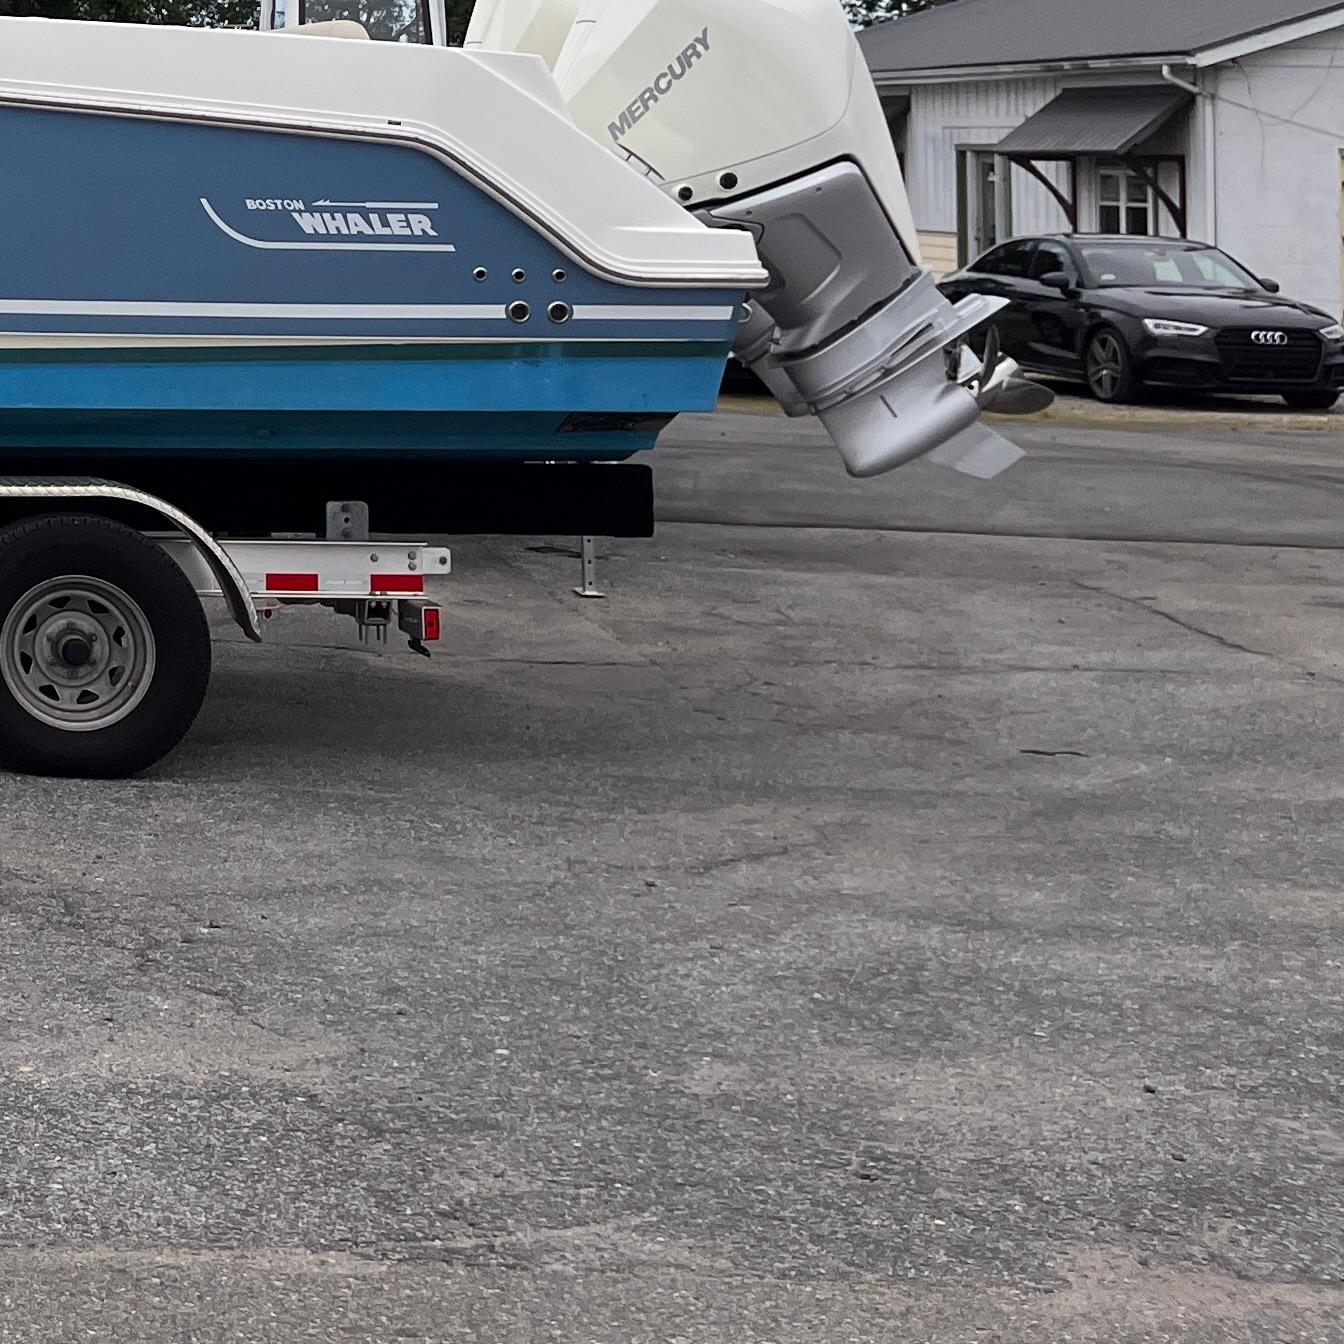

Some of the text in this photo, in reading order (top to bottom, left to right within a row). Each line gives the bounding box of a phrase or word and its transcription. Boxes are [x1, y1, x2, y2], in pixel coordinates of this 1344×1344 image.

[607, 26, 710, 142] MERCURY
[245, 198, 305, 210] BOSTON
[291, 212, 439, 236] WHALER
